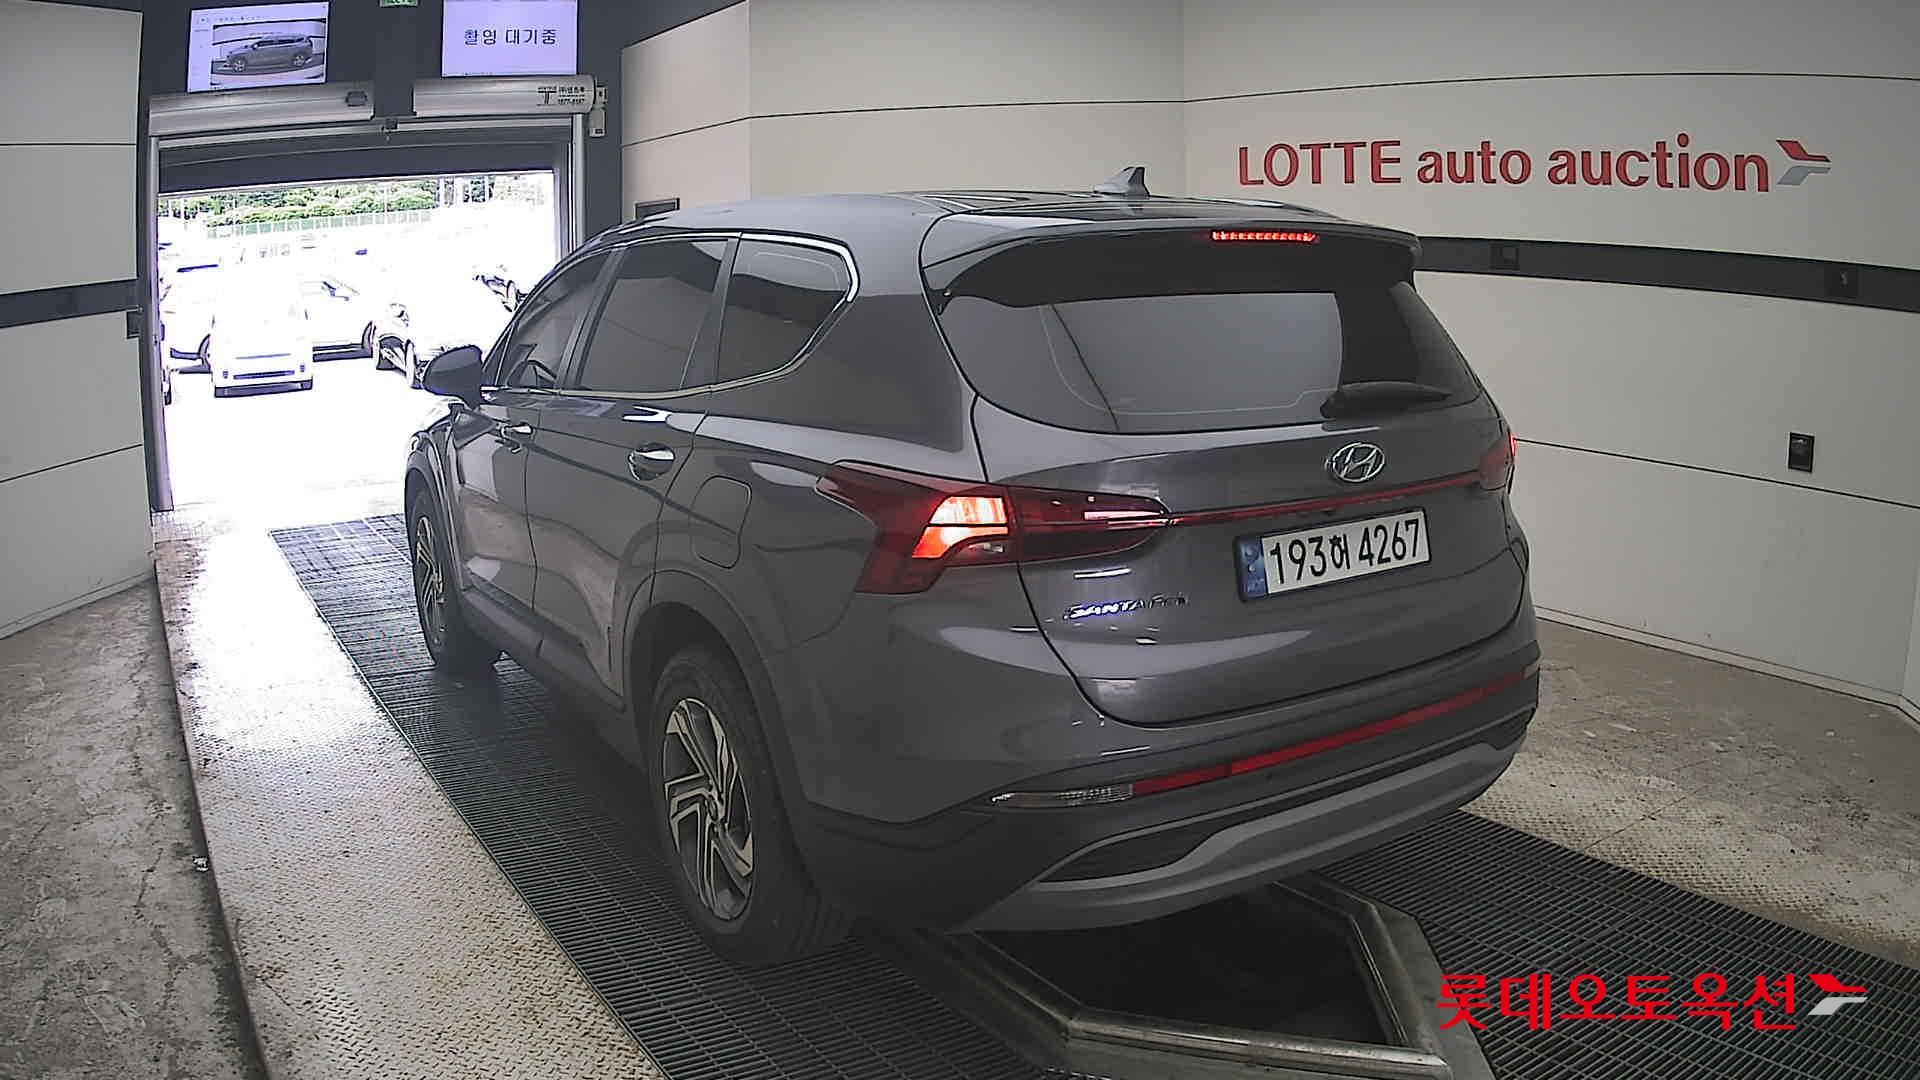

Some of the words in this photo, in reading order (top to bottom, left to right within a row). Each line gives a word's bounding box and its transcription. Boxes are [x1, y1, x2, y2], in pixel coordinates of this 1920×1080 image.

[505, 28, 557, 45] 대기중
[1239, 140, 1400, 187] LOTTE
[1417, 141, 1532, 185] auto
[1548, 133, 1769, 192] auction
[1358, 518, 1419, 567] 4267
